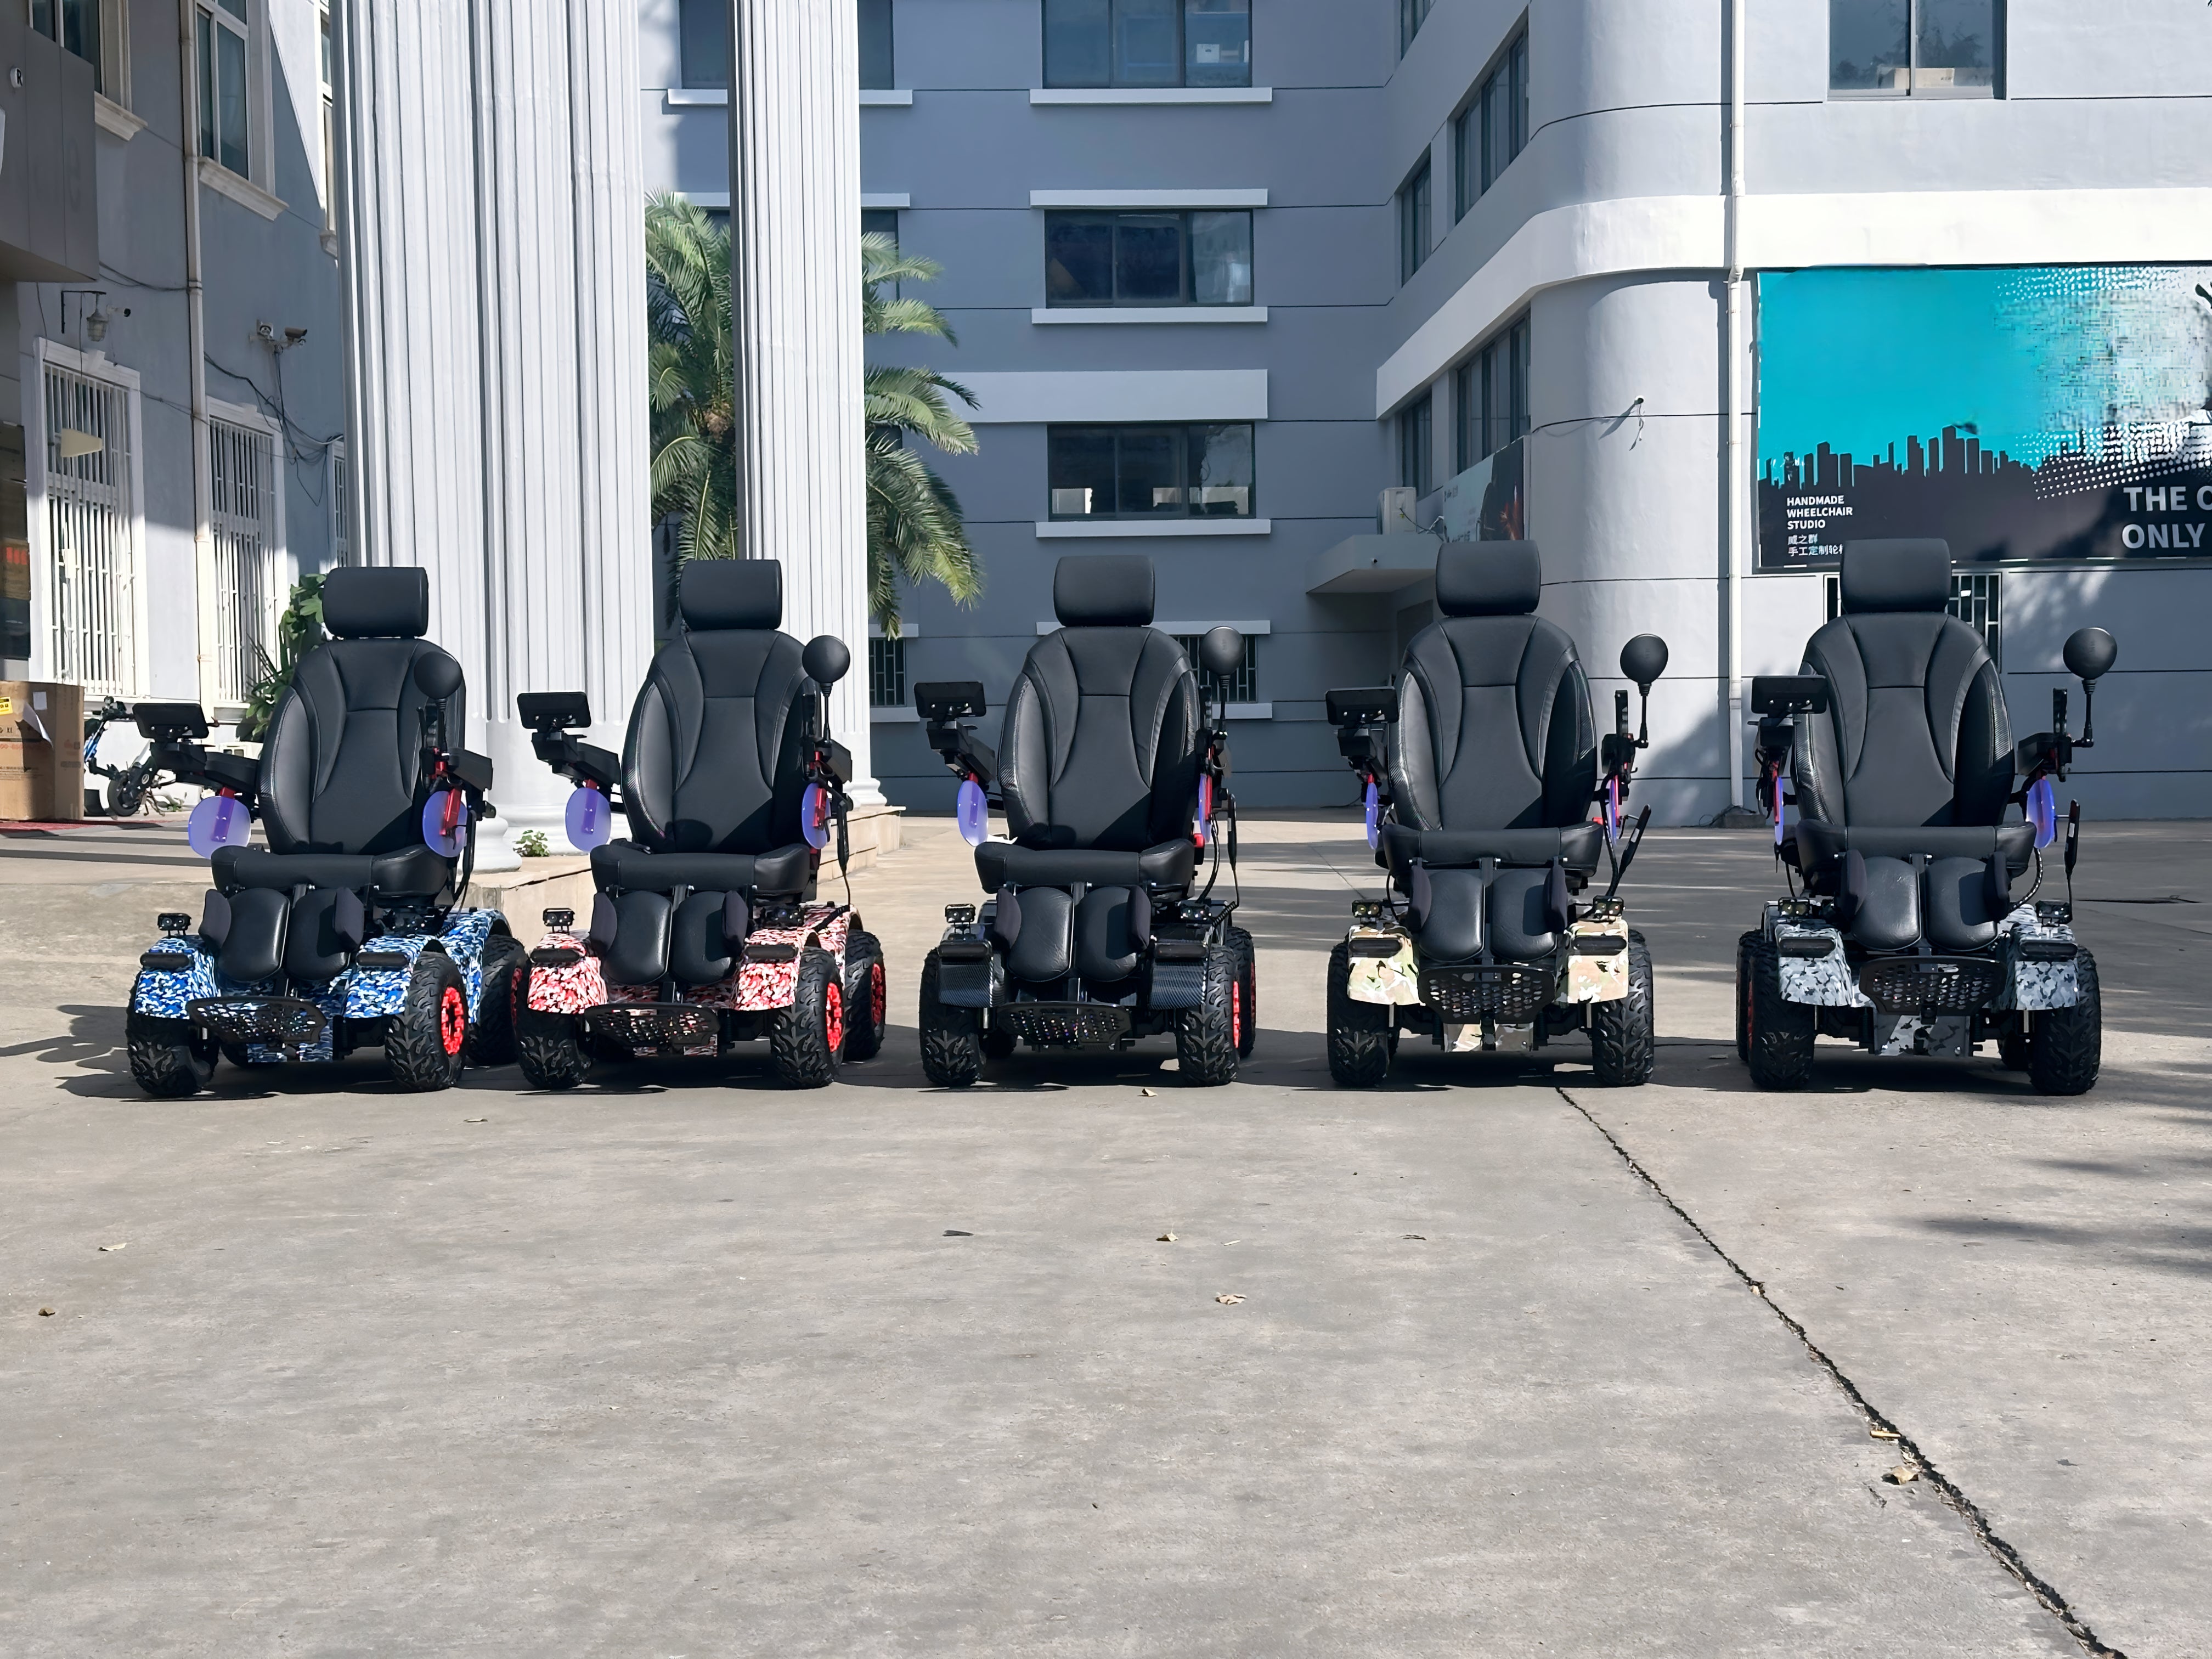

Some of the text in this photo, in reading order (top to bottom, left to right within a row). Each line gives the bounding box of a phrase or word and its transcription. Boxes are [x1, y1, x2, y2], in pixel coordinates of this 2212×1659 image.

[1787, 495, 1844, 506] HANDMADE
[2123, 486, 2187, 511] THE
[1786, 506, 1853, 518] WHEELCHAIR
[1787, 520, 1826, 530] STUDIO
[2122, 523, 2205, 549] ONLY
